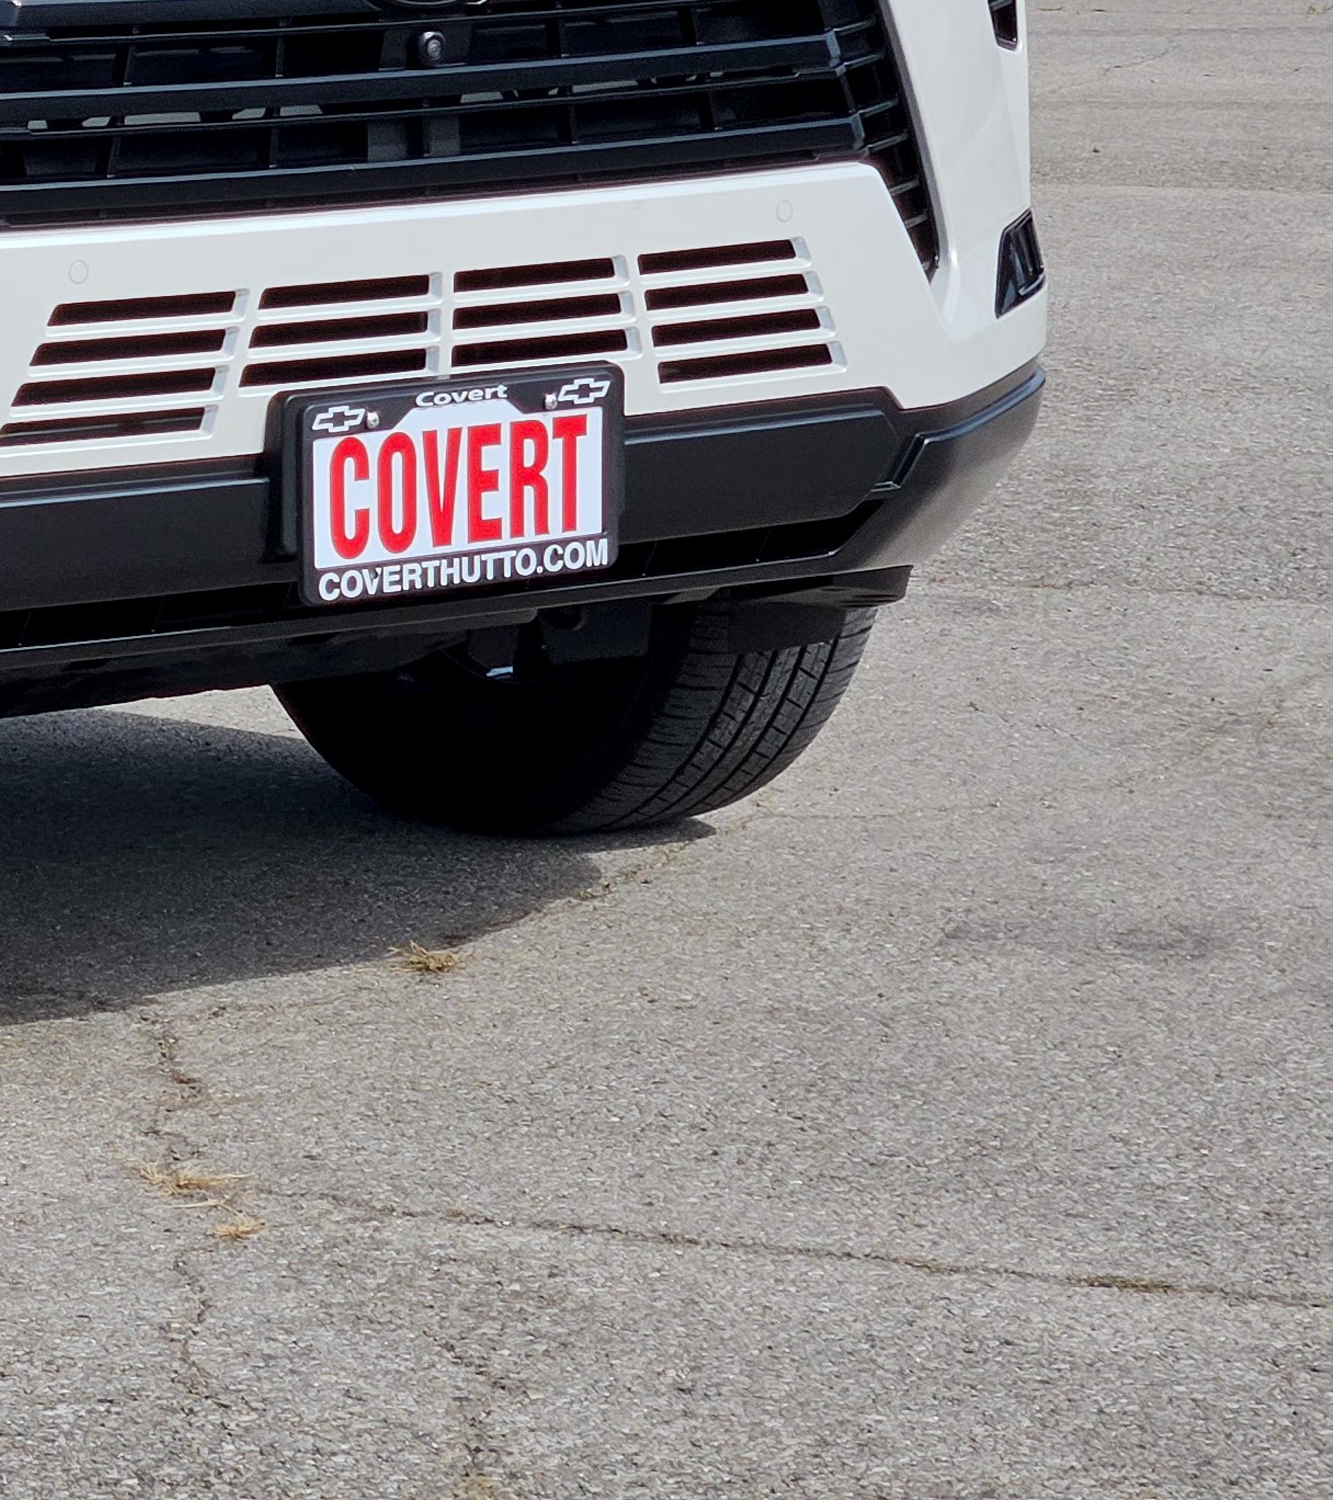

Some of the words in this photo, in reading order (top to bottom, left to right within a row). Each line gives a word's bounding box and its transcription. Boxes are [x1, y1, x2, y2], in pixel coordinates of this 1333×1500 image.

[415, 384, 508, 407] Covert
[329, 414, 588, 560] COVERT
[318, 538, 609, 601] COVERTHUTTO.COM
